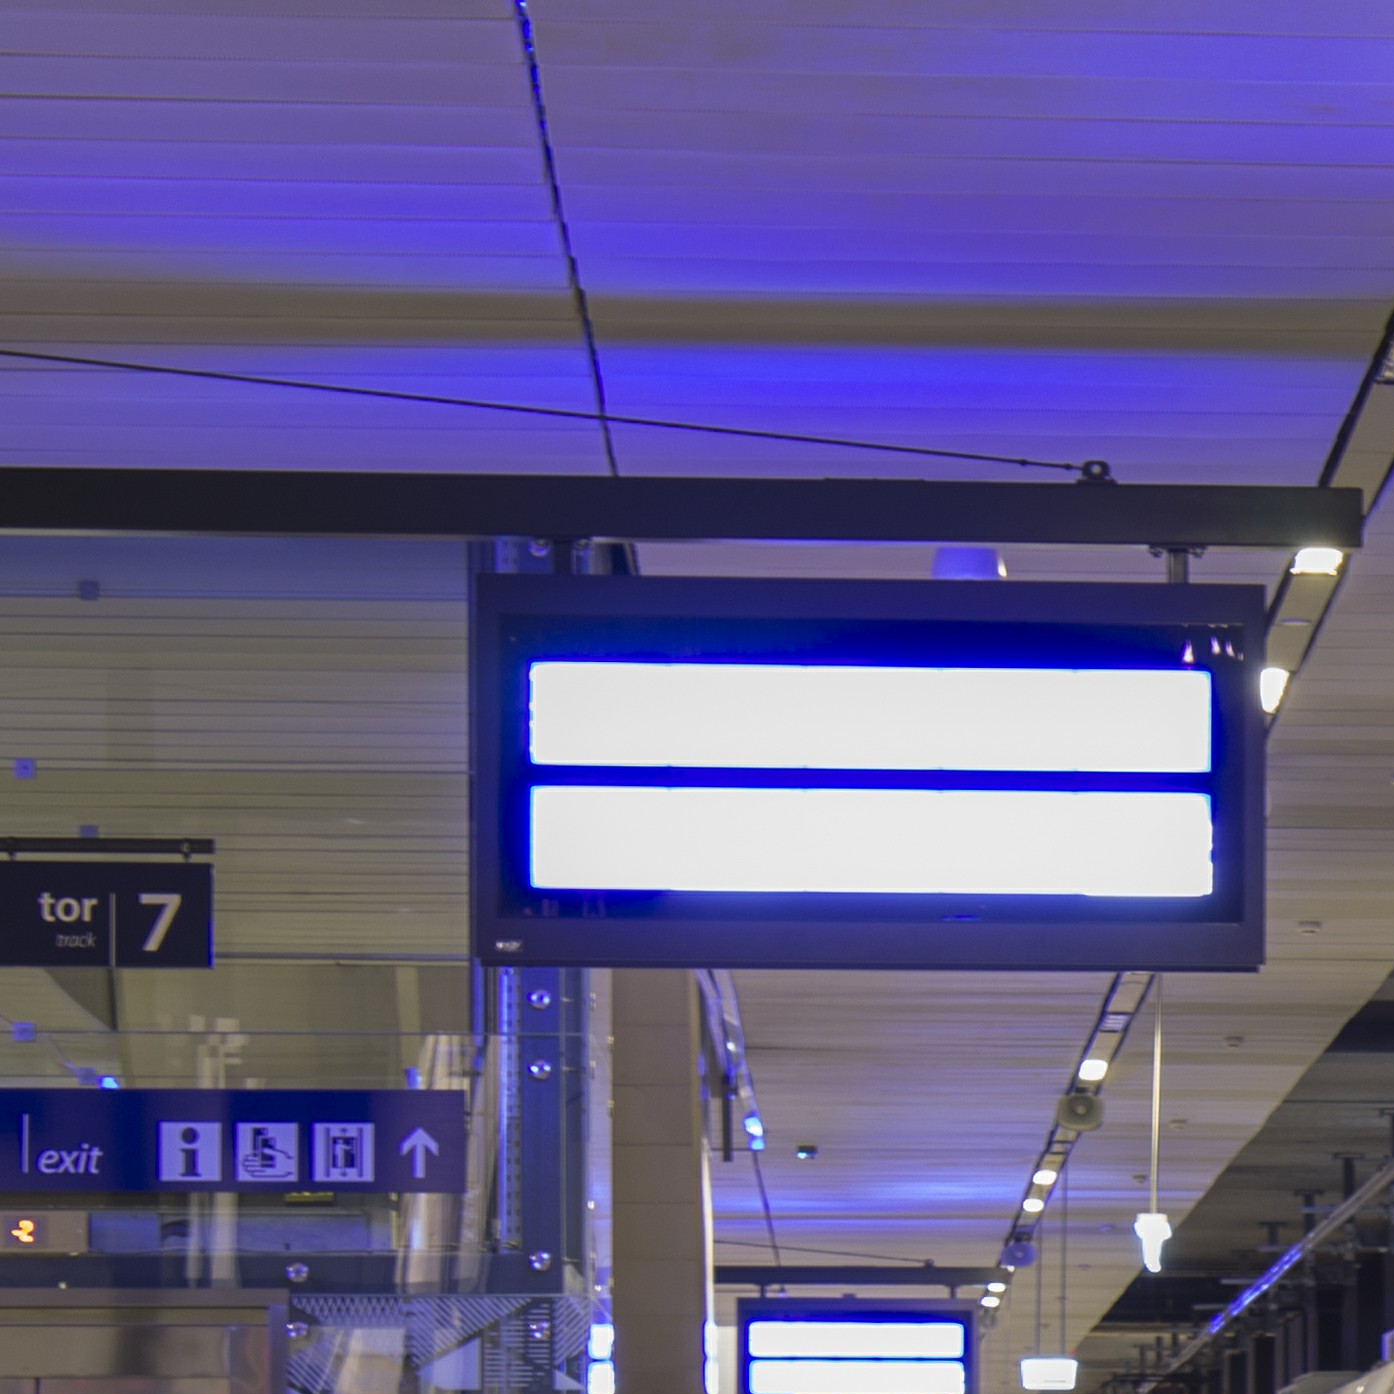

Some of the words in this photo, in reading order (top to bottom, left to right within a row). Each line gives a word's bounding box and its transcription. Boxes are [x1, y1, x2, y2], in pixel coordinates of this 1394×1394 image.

[38, 892, 98, 922] tor
[138, 893, 182, 952] 7
[56, 932, 97, 949] track
[36, 1143, 103, 1177] exit
